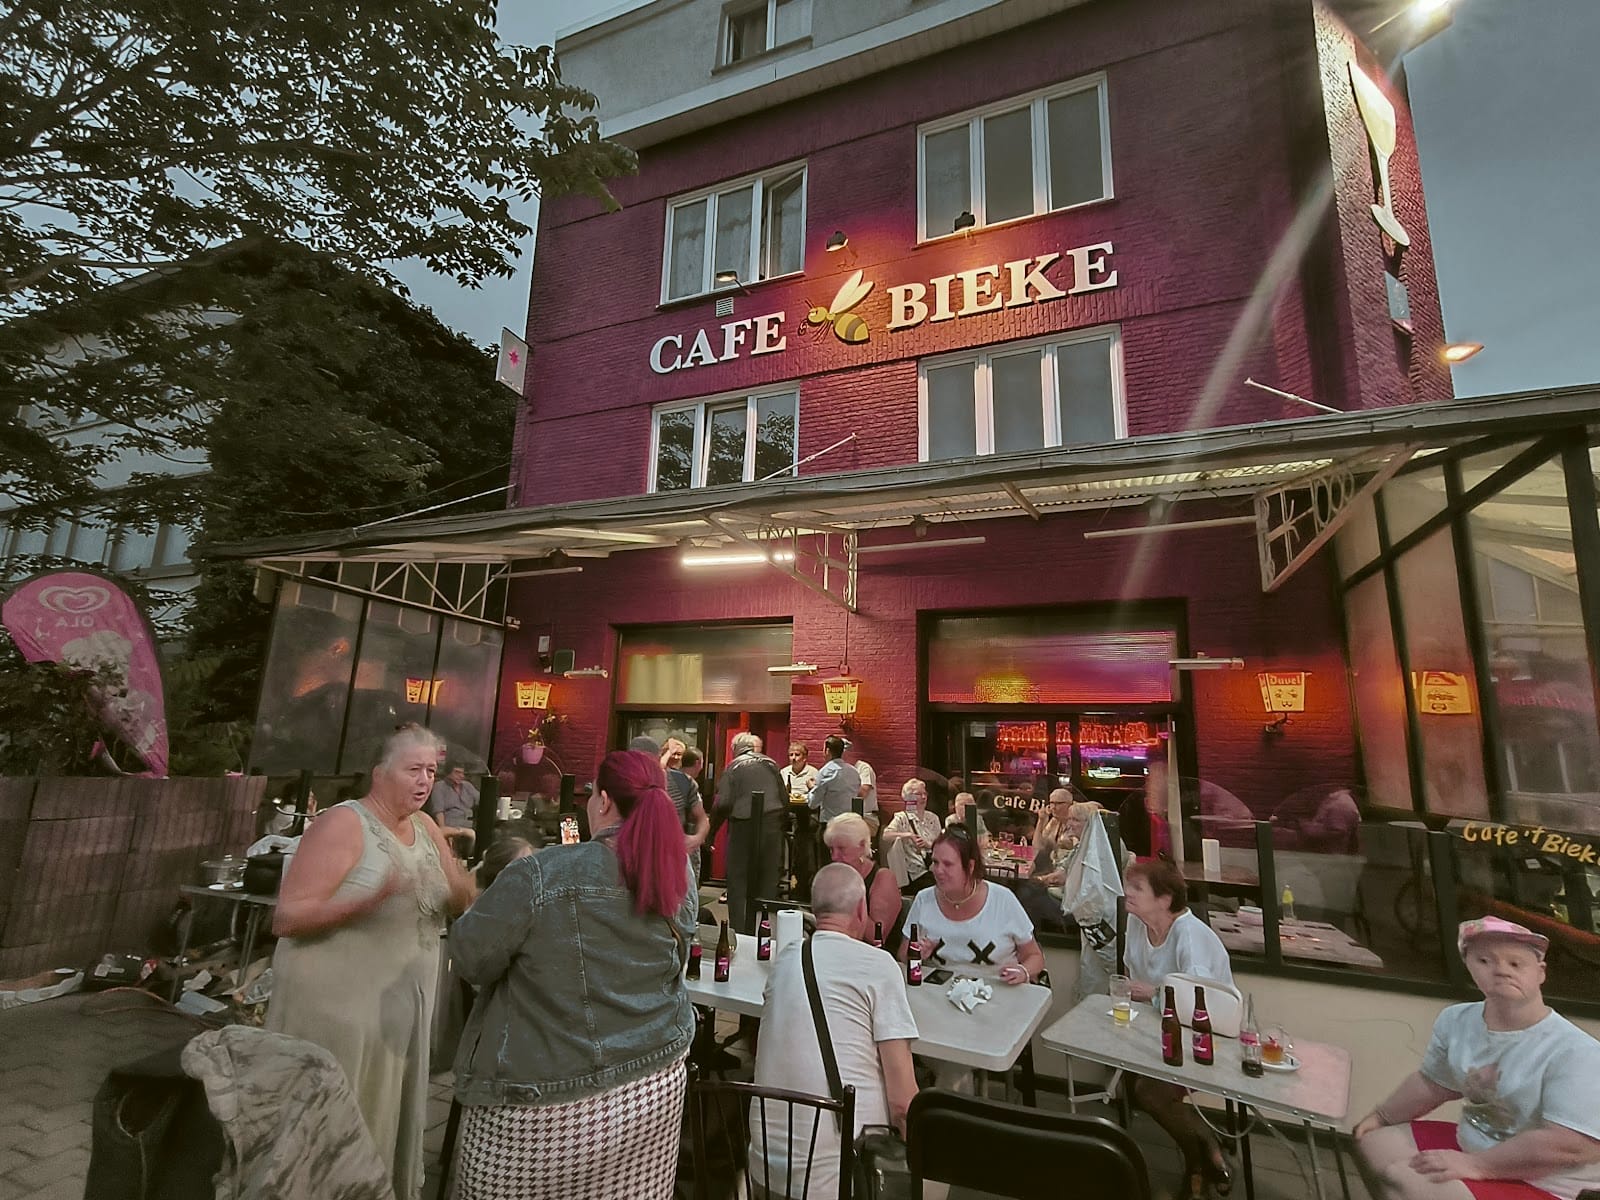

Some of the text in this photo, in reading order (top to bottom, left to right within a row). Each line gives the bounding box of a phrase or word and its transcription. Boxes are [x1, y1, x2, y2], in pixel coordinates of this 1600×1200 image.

[649, 241, 1118, 374] CAFE BIEKE
[1270, 675, 1300, 685] Duvel
[993, 795, 1026, 809] Cafe
[1463, 821, 1518, 846] Cafe
[1541, 833, 1600, 866] Biek
